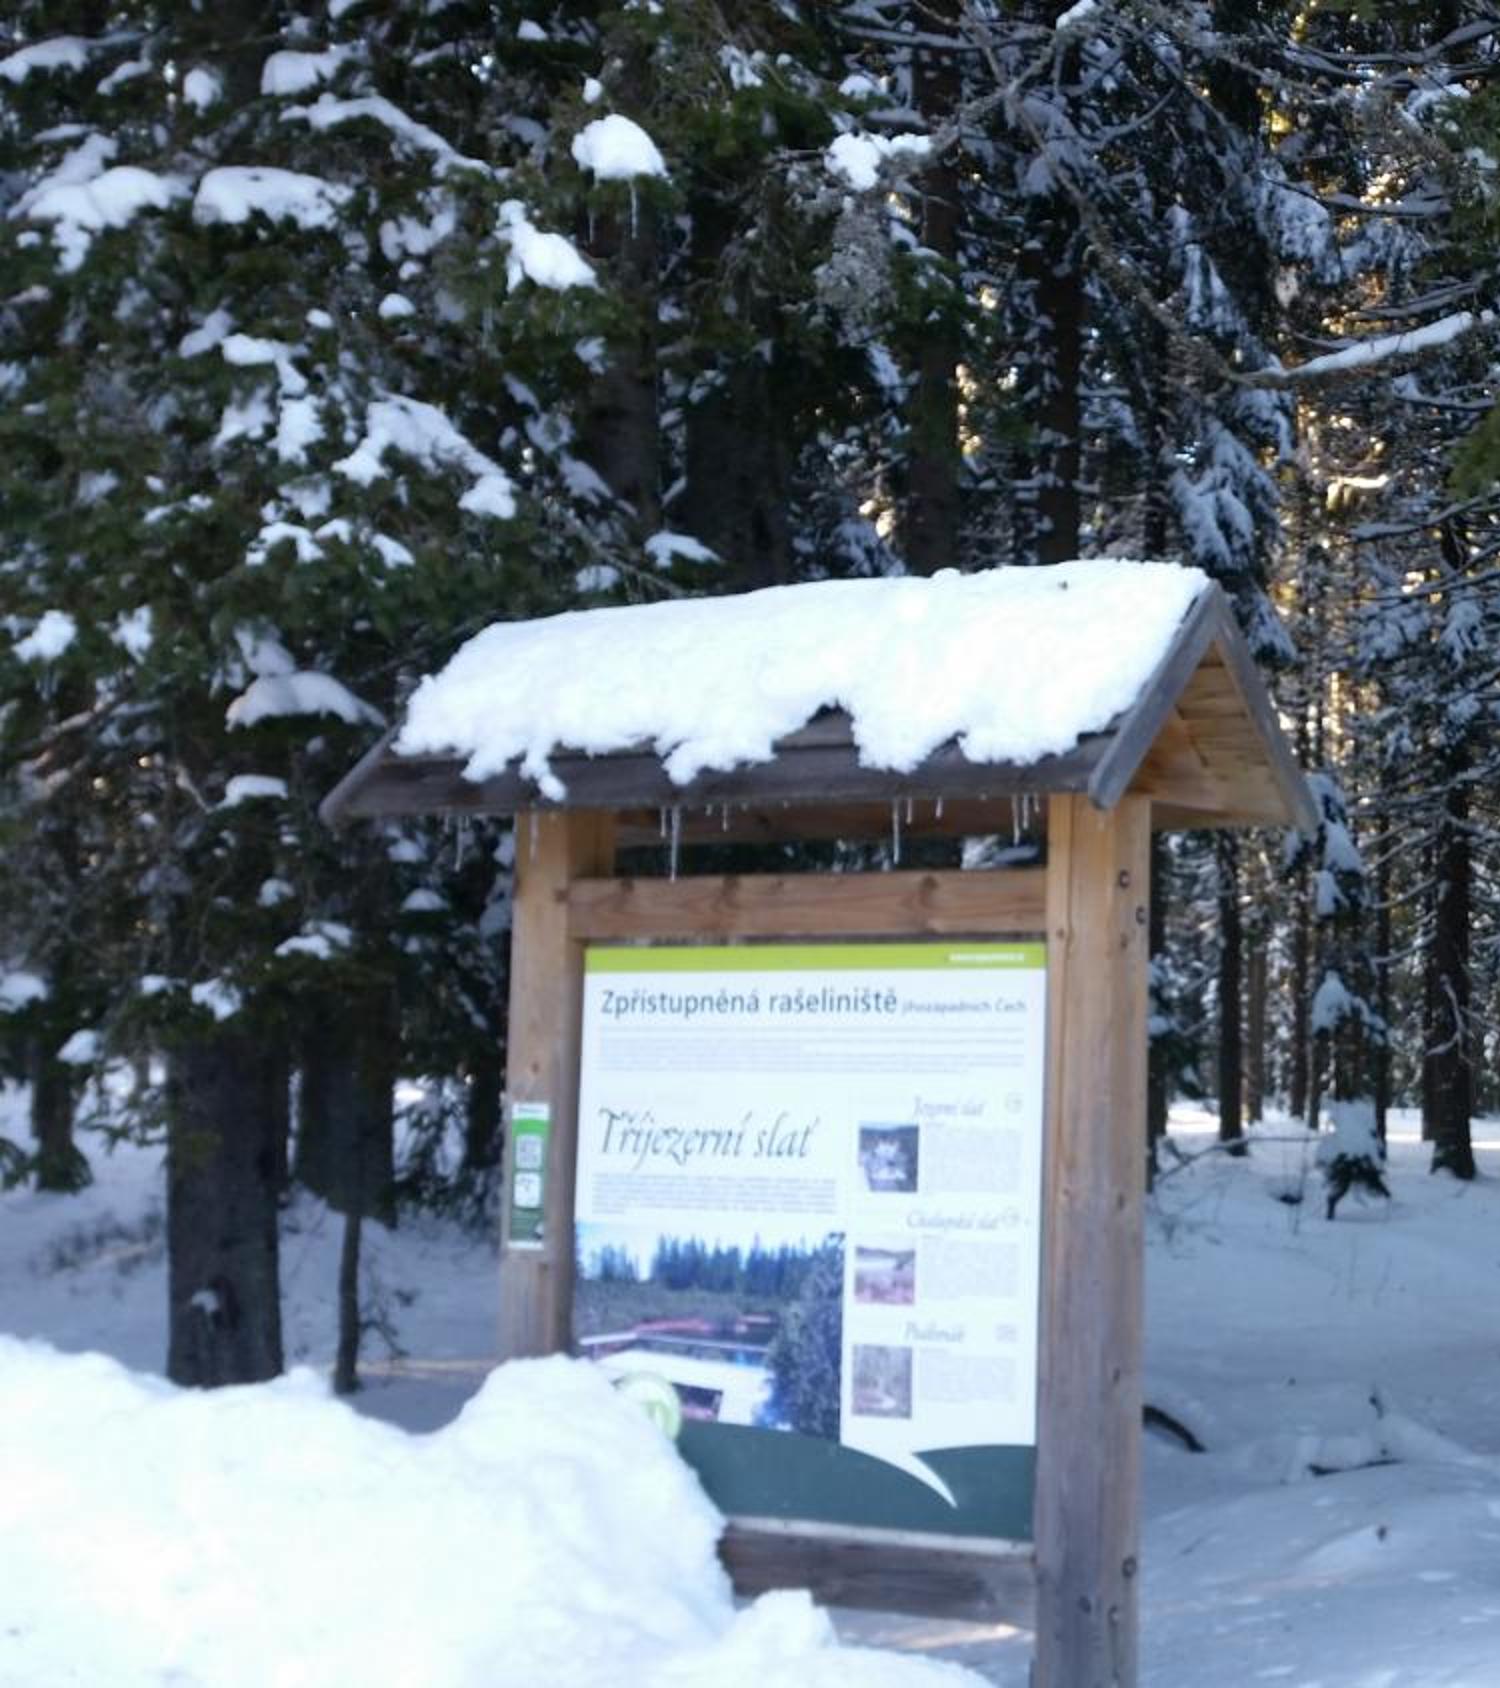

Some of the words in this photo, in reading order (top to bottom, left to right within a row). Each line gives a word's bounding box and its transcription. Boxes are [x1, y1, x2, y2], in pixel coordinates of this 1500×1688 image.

[599, 988, 761, 1019] Zpřístupněná
[768, 985, 898, 1014] rašeliniště
[597, 1107, 752, 1172] Tříjezerní
[752, 1110, 820, 1158] slať
